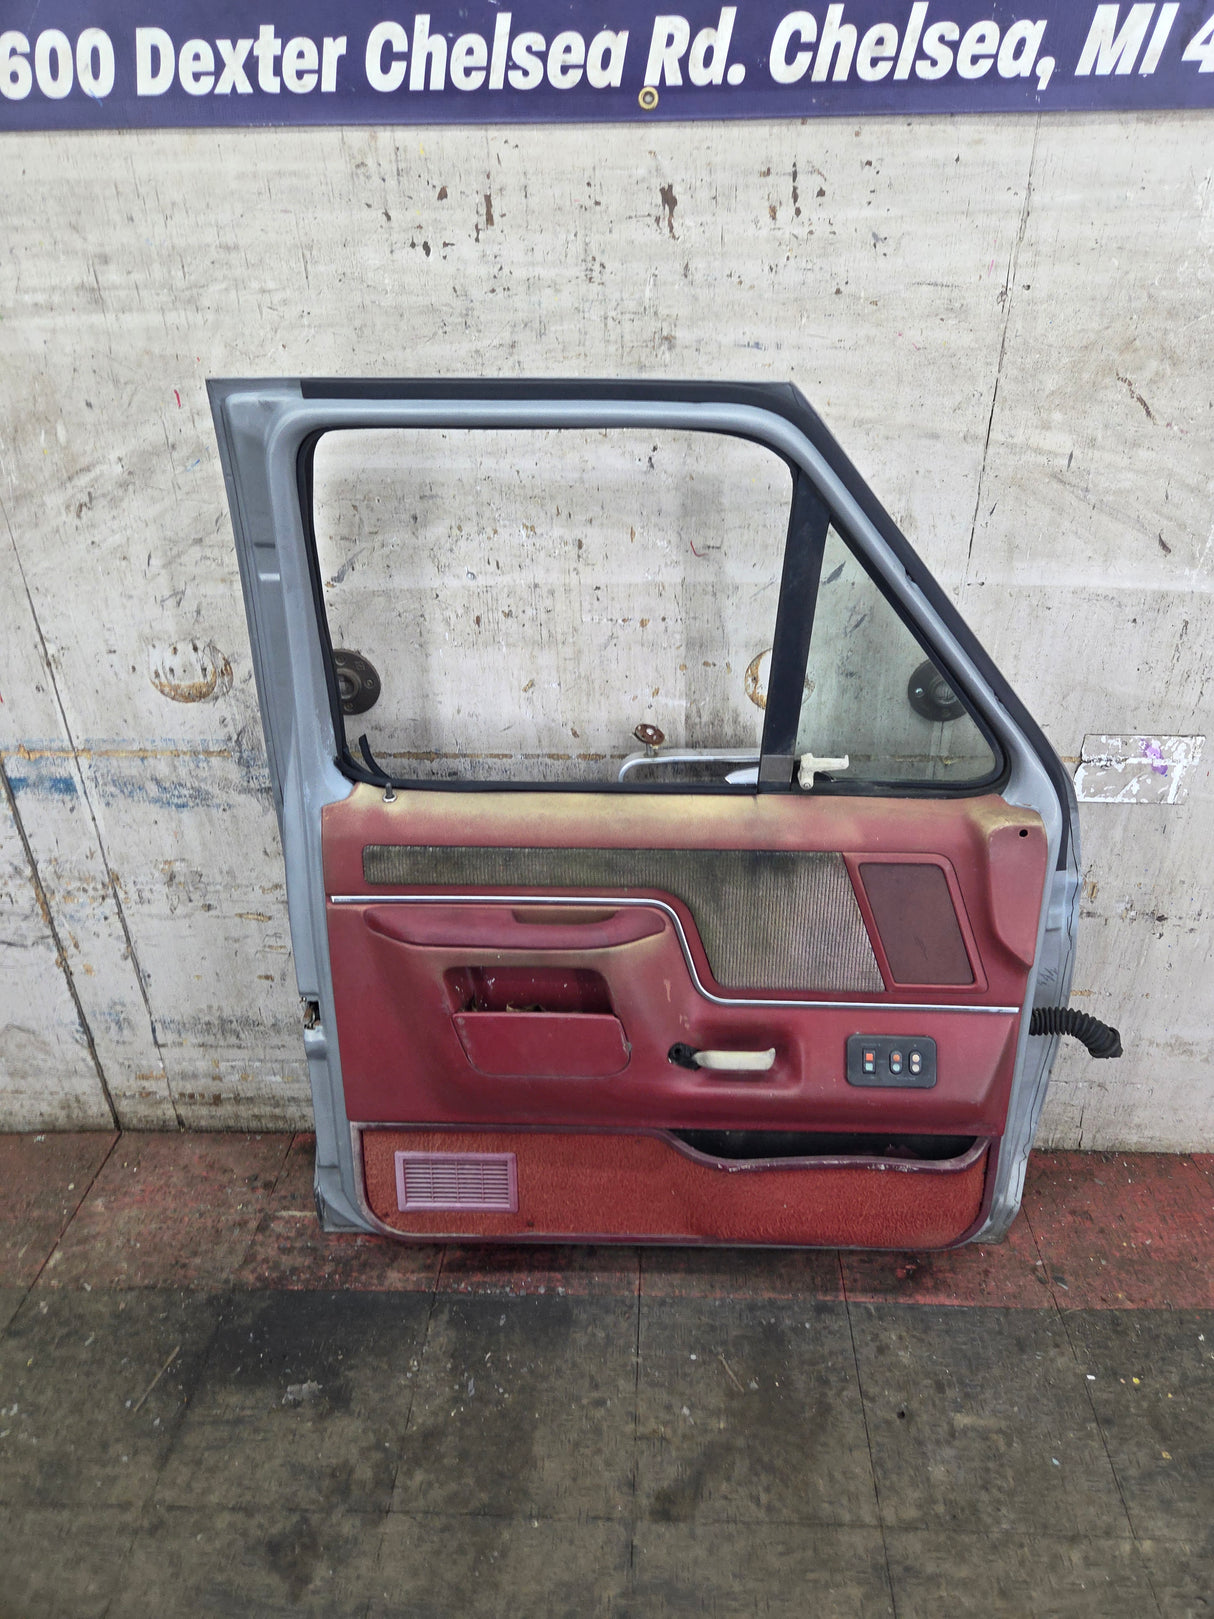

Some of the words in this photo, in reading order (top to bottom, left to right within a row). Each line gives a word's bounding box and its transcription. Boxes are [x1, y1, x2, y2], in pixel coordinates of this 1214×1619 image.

[0, 27, 115, 100] 600
[135, 24, 348, 97] Dexter
[364, 11, 630, 93] Chelsea
[643, 5, 746, 88] Rd.
[768, 0, 1056, 91] Chelsea,
[1073, 1, 1181, 78] MI
